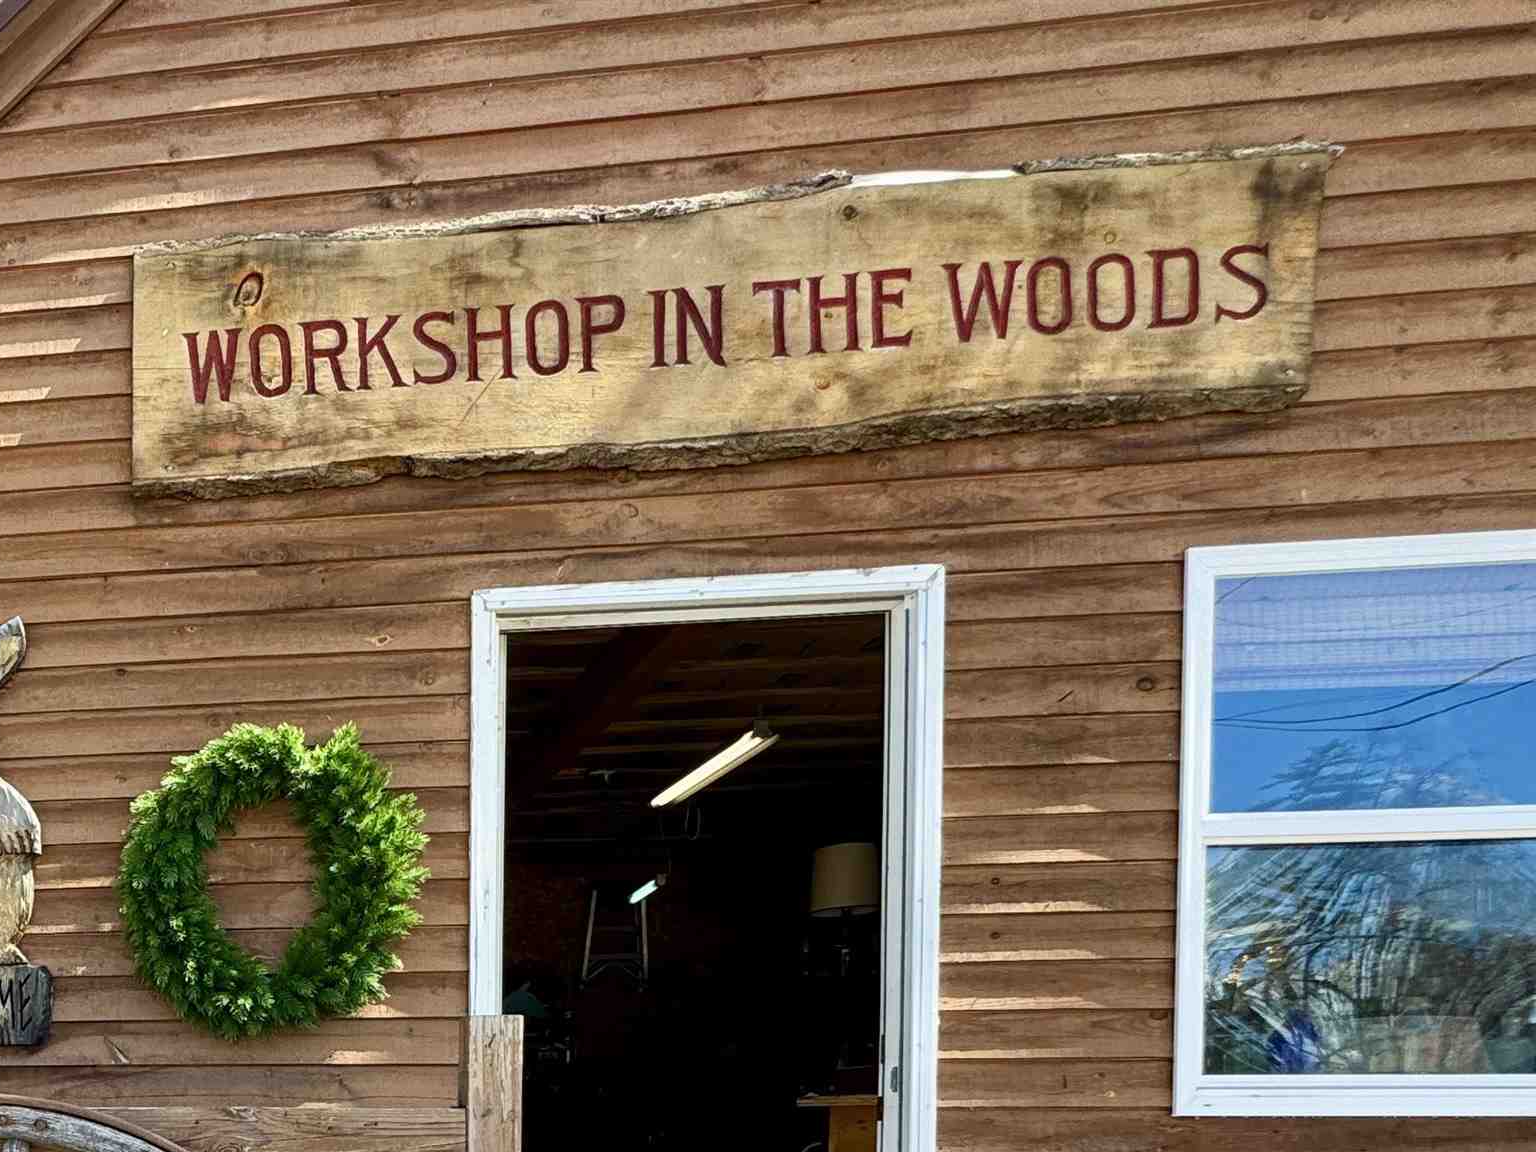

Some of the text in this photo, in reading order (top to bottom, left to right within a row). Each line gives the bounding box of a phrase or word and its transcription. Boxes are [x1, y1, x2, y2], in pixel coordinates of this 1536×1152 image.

[181, 242, 1269, 405] WORKSHOP IN THE WOODS
